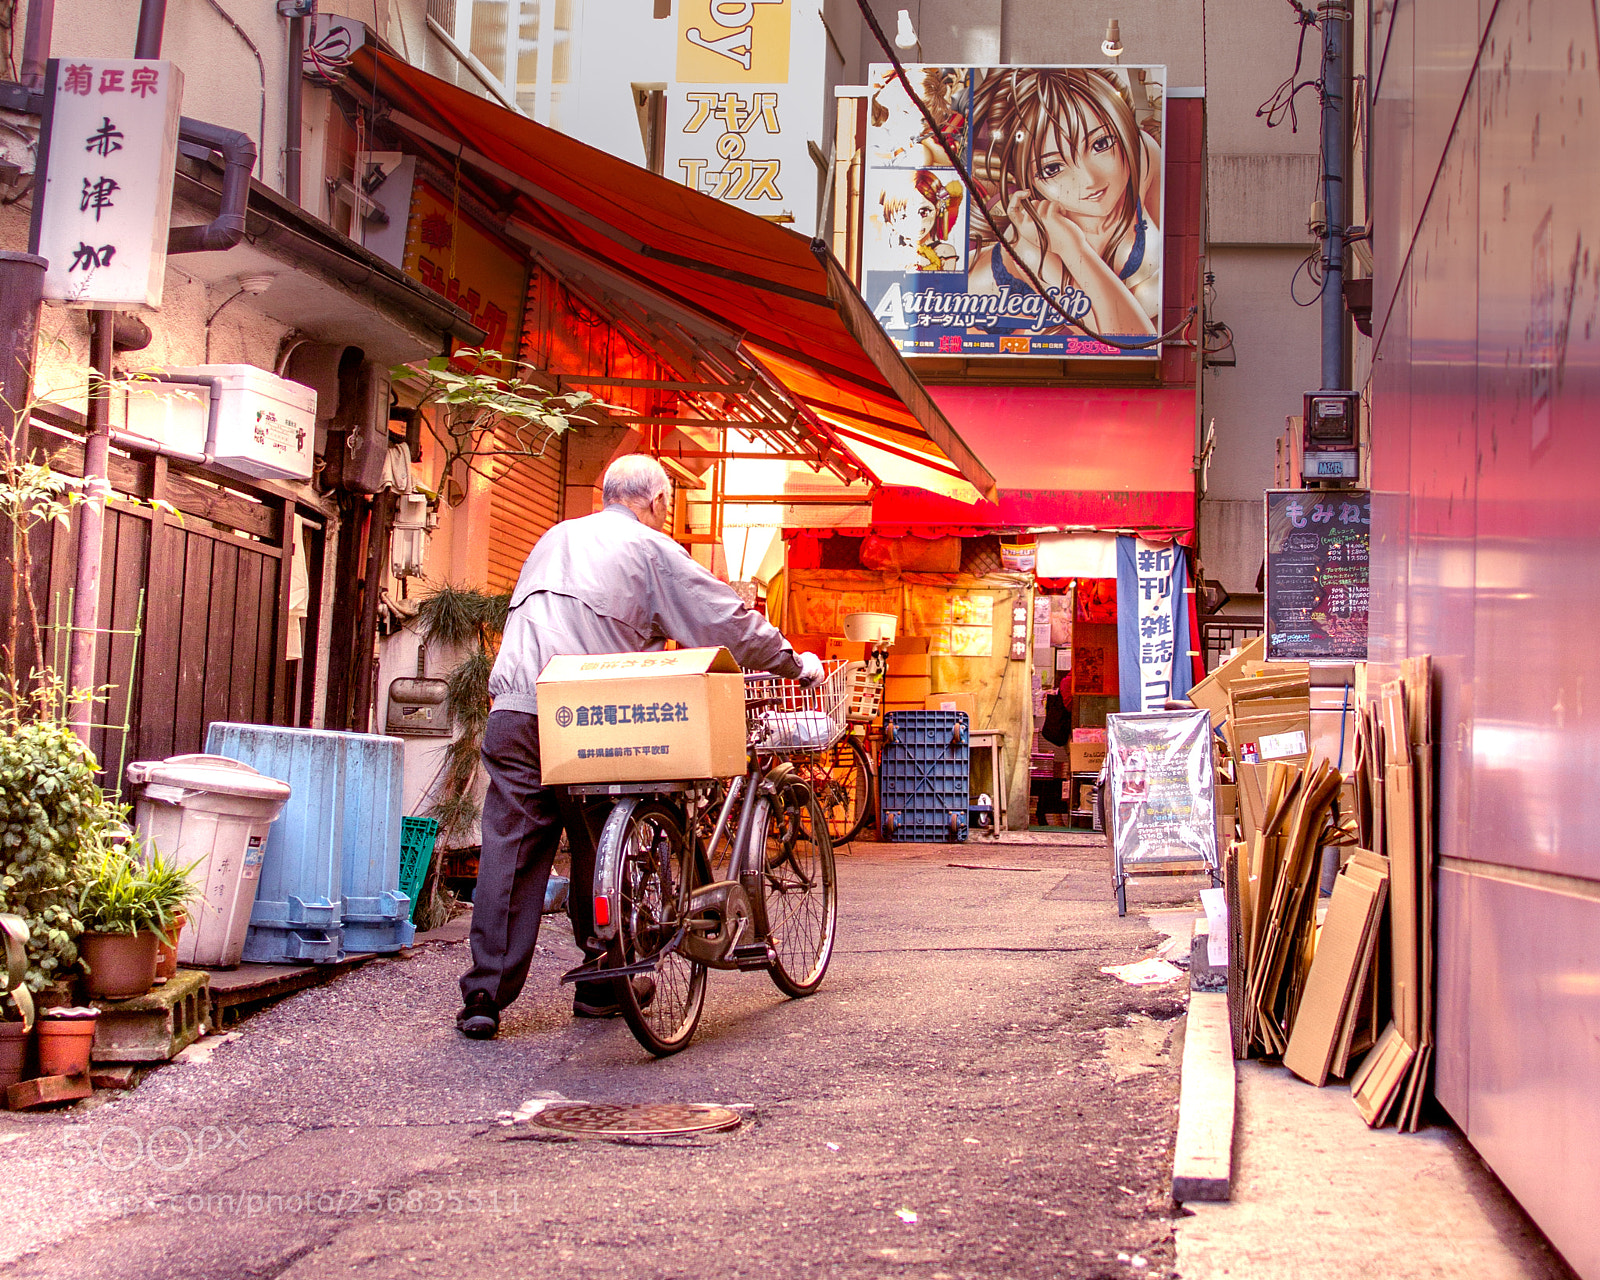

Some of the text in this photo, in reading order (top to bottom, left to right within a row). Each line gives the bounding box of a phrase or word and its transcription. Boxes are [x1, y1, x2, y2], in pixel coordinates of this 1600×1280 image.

[64, 63, 159, 99] 菊正宗
[683, 92, 781, 134] アキバ
[716, 132, 745, 160] の
[68, 117, 124, 273] 赤津加
[679, 159, 783, 200] エックス
[919, 314, 998, 329] オータムリーフ
[576, 701, 689, 726] 倉茂電工株式会社
[577, 744, 670, 759] 福井県越前市下平吹町
